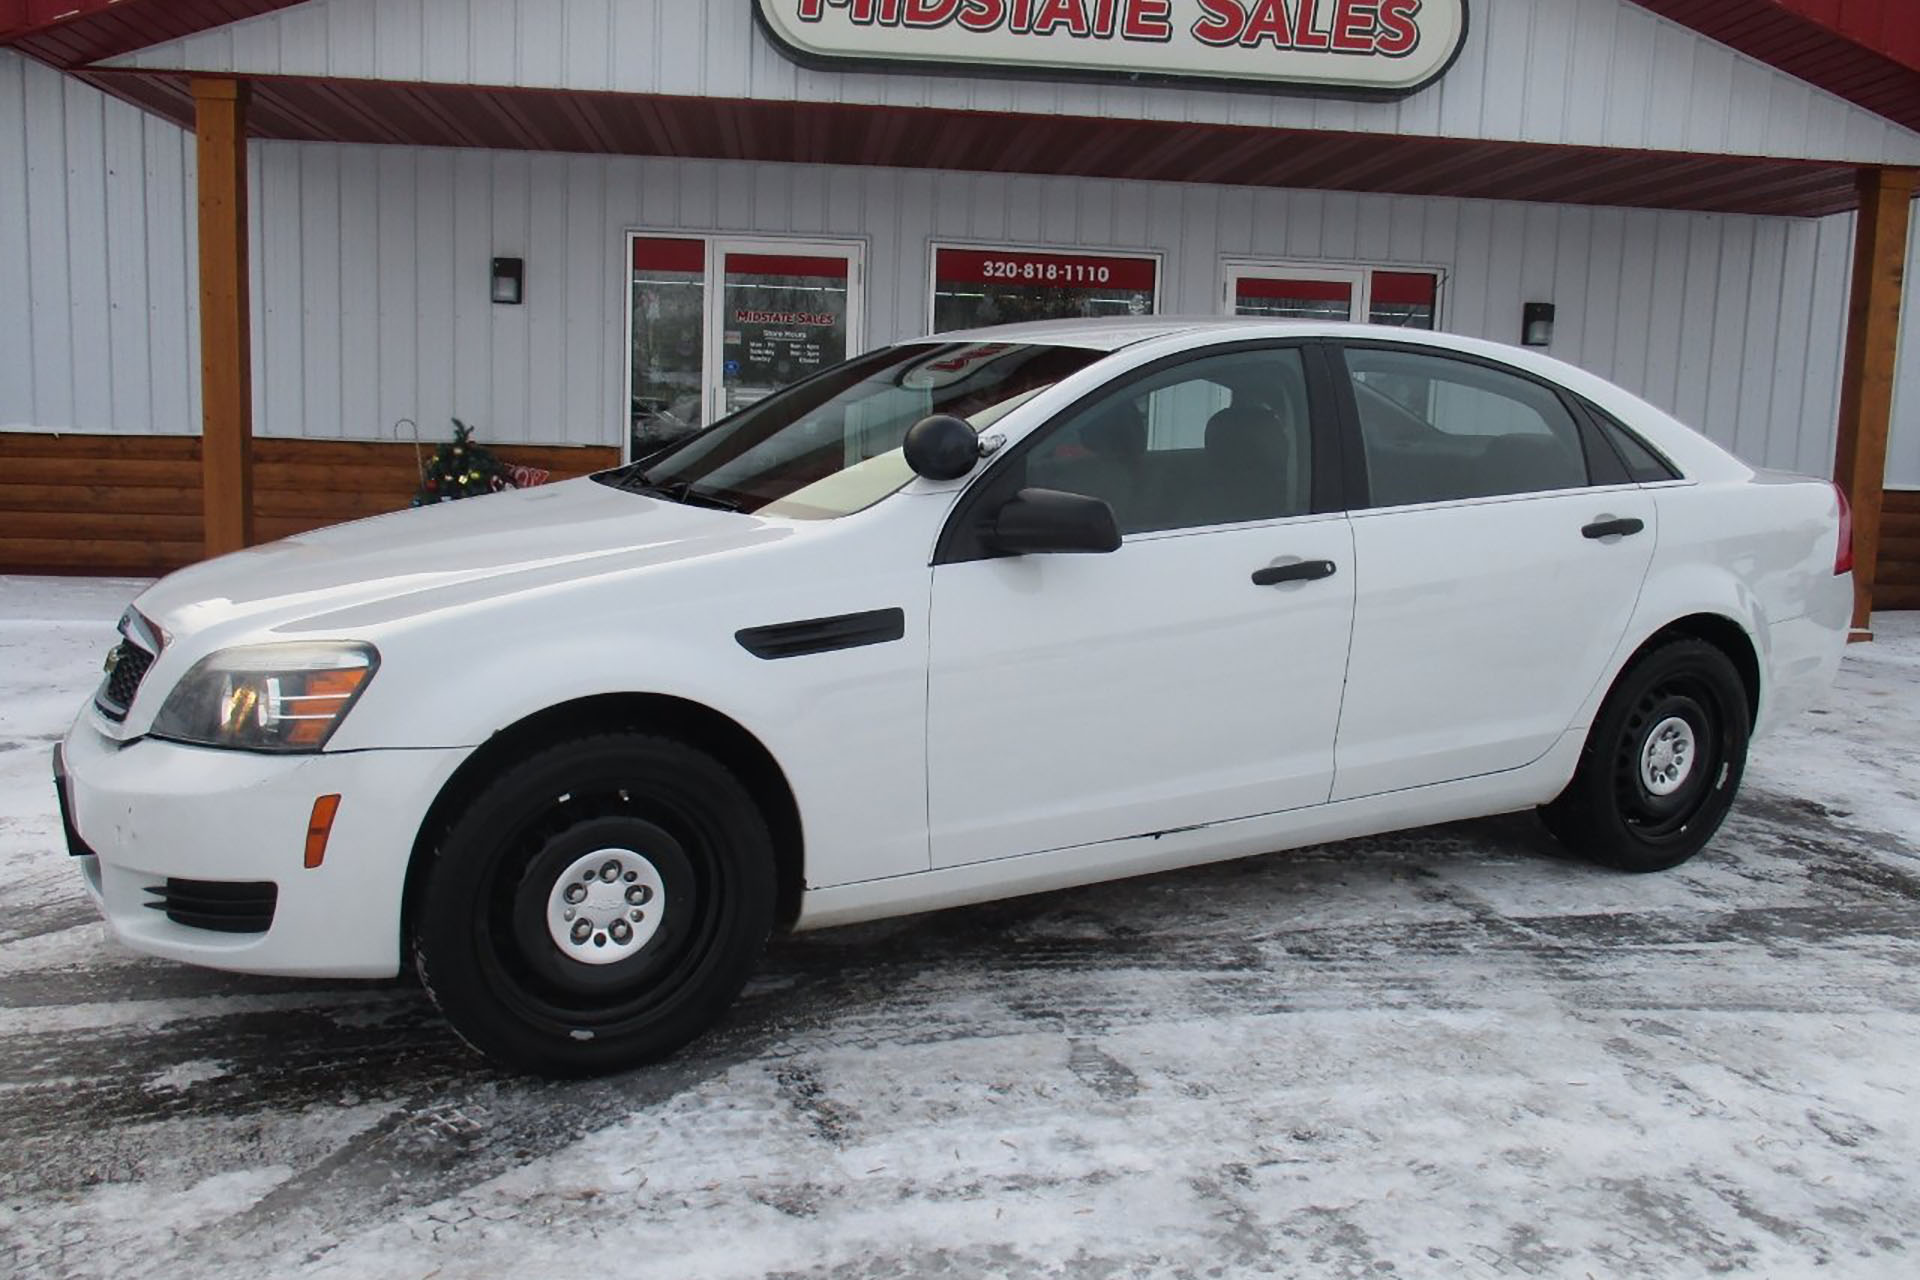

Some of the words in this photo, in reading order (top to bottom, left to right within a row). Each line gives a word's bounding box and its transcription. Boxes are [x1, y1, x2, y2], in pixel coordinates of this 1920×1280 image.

[1191, 0, 1421, 58] SALES
[983, 261, 1109, 282] 320-818-1110
[736, 311, 795, 325] MIDSTATE
[798, 312, 835, 327] SALES
